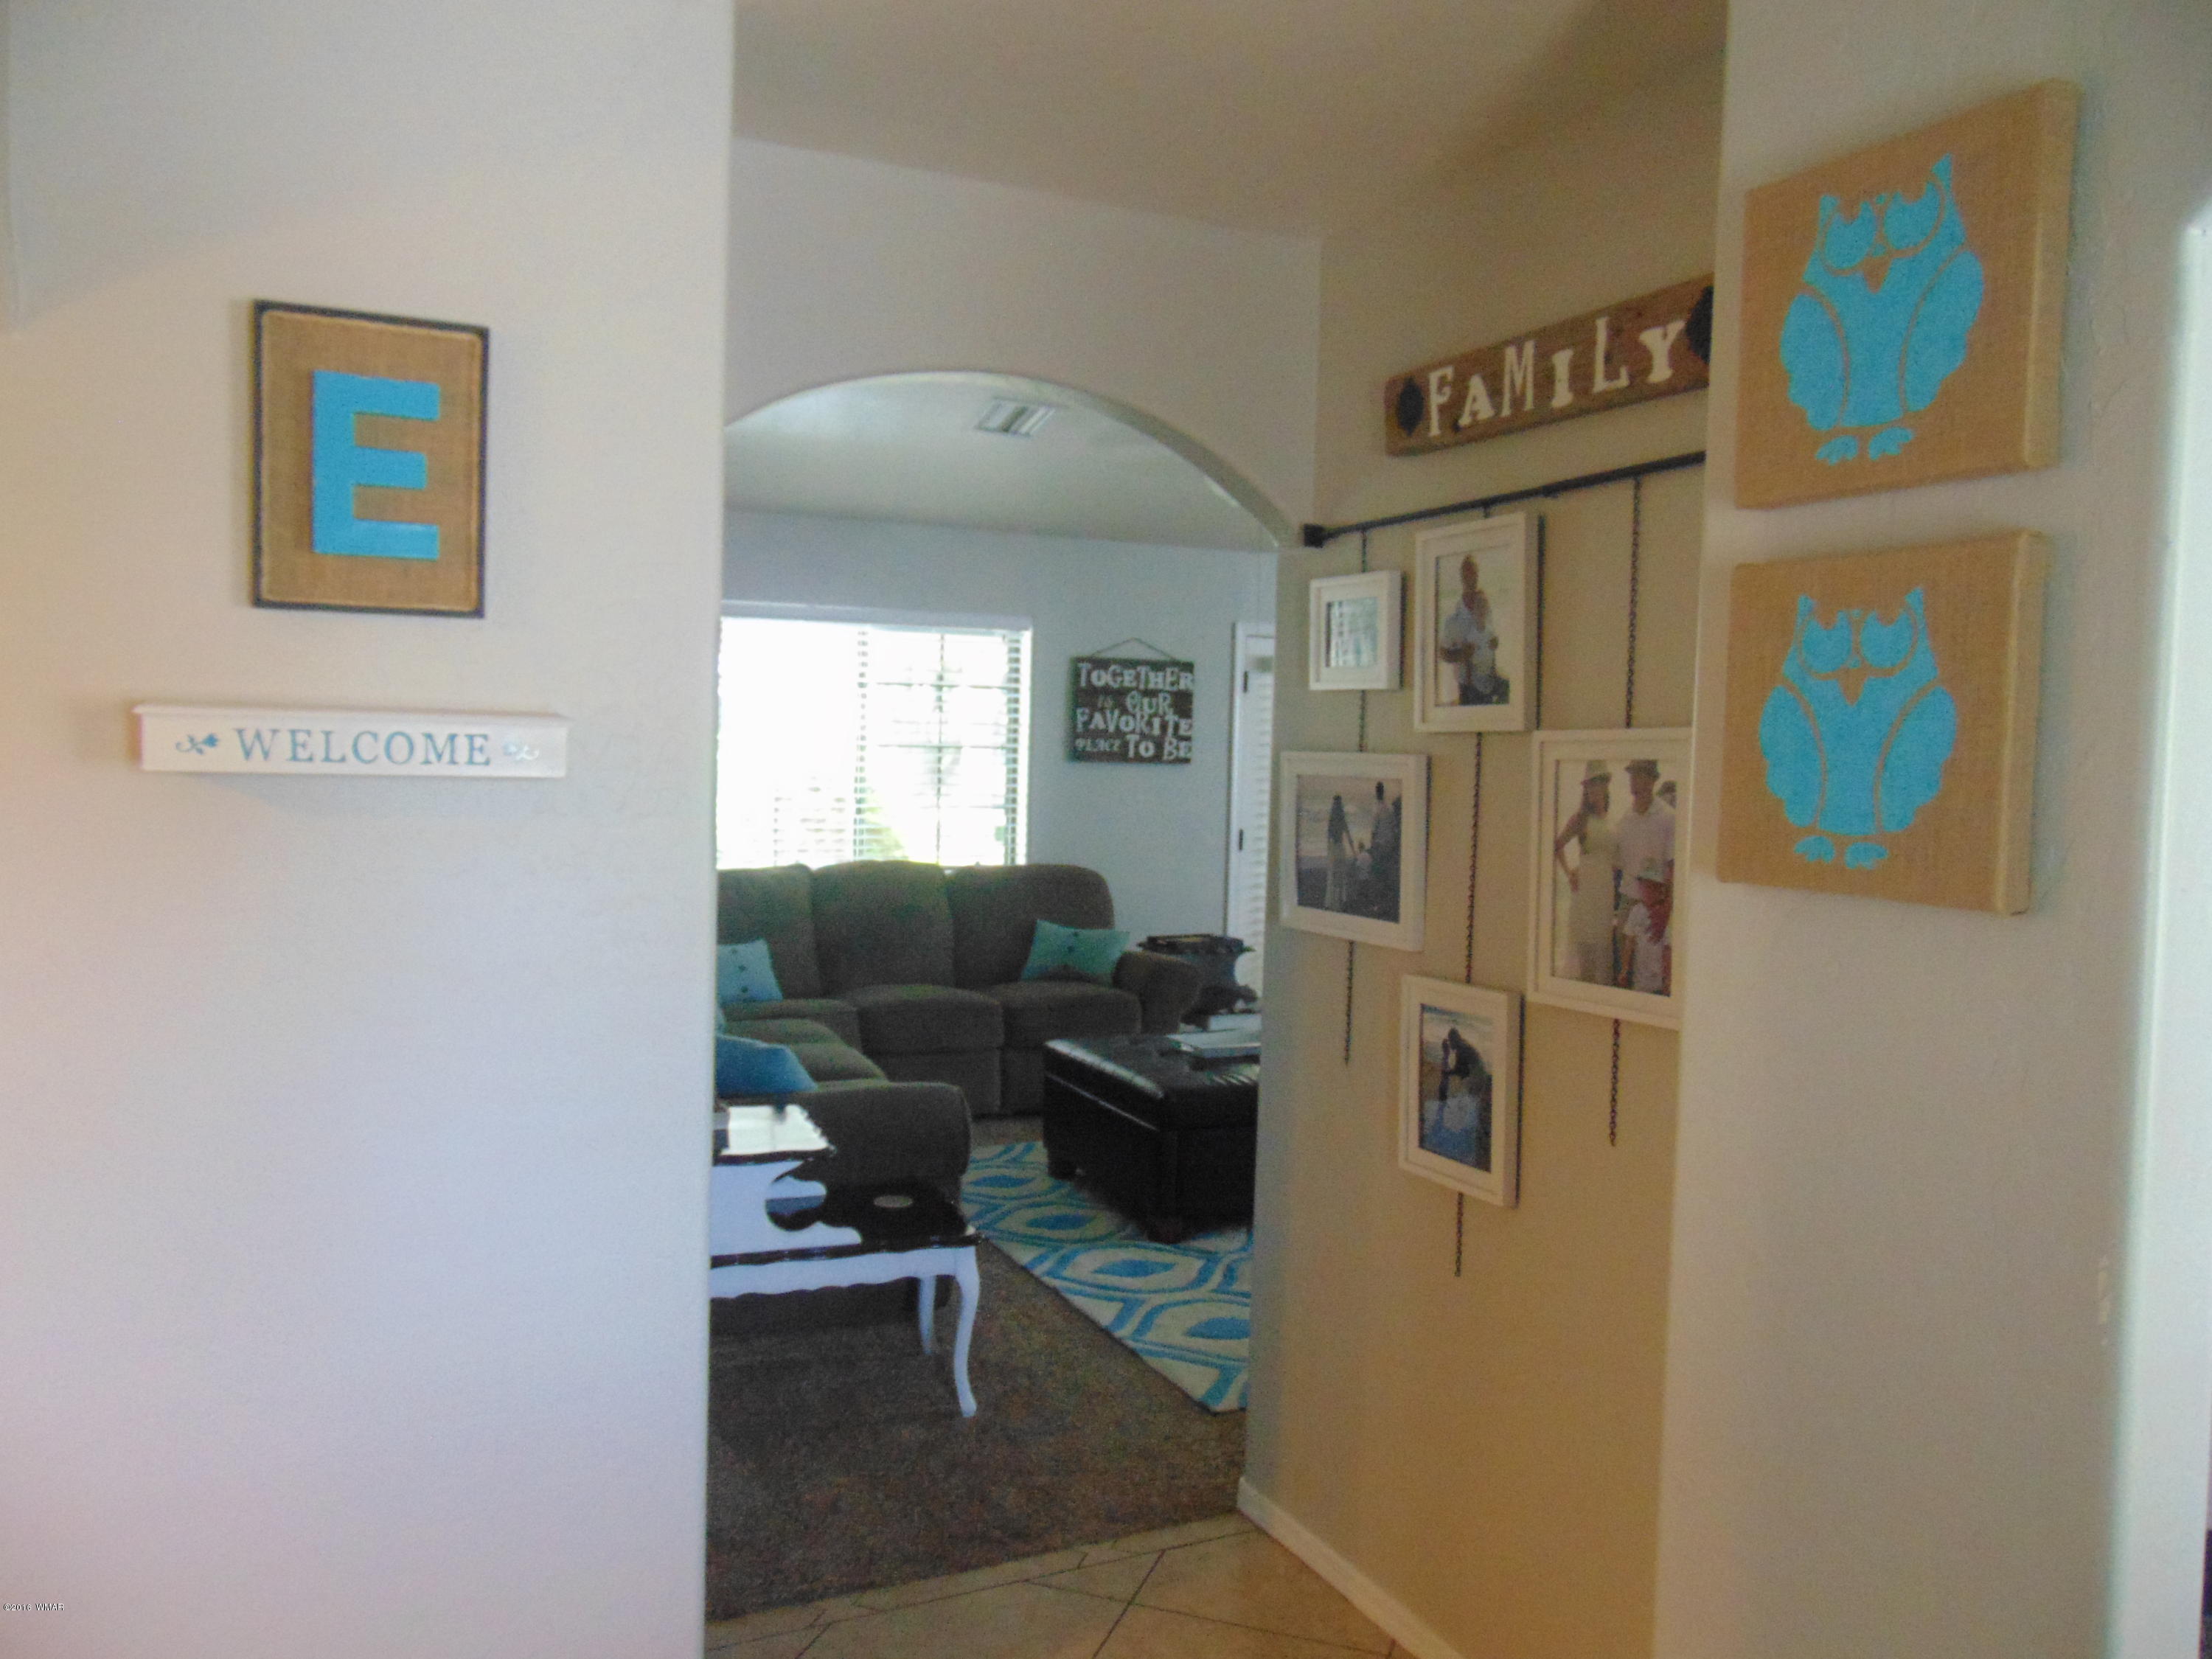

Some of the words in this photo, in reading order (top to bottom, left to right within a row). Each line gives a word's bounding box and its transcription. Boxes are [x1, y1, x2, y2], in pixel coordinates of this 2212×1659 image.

[1427, 315, 1686, 437] FAMILY
[312, 369, 440, 560] E
[1077, 662, 1194, 692] TOGETHER
[1127, 690, 1173, 715] OUR
[233, 727, 492, 766] WELCOME
[1126, 734, 1155, 759] TO
[1162, 736, 1192, 760] BE
